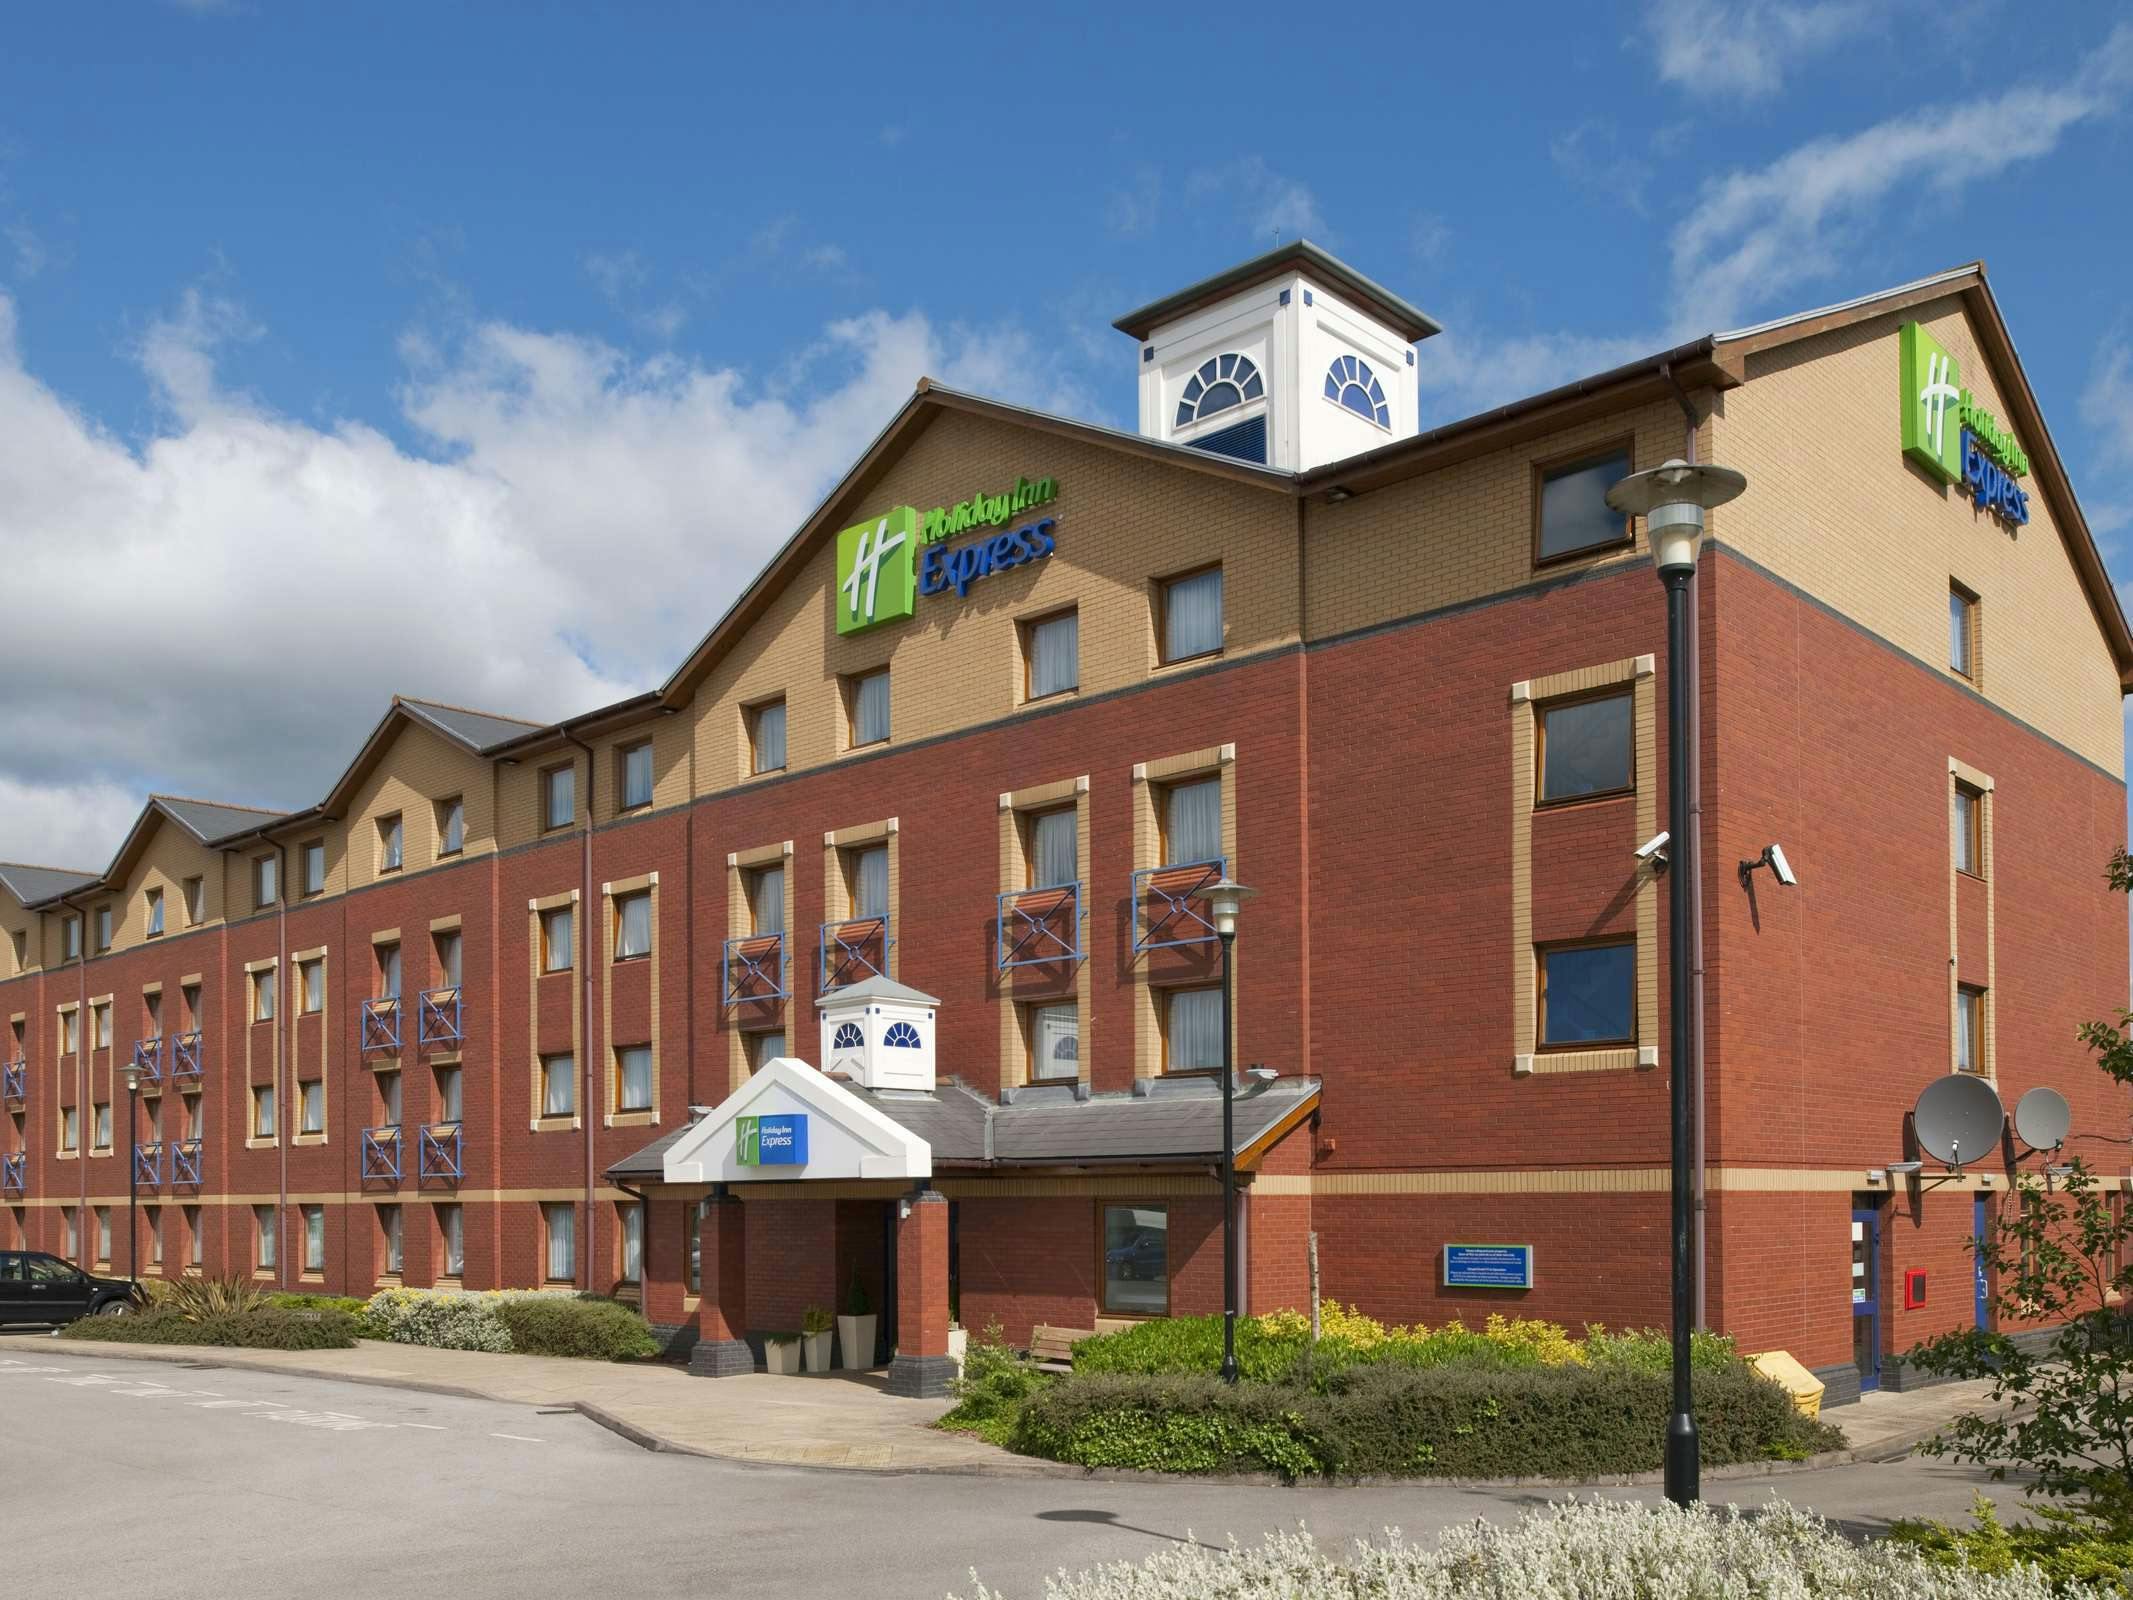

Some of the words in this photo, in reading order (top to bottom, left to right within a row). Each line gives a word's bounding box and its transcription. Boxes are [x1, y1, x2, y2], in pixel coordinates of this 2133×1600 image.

[920, 491, 1013, 544] Holiday
[1011, 476, 1058, 511] Inn
[1960, 430, 2030, 525] Express
[919, 517, 1056, 597] Express
[761, 1126, 781, 1135] Holiday
[782, 1125, 792, 1134] Inn
[761, 1135, 792, 1148] Express
